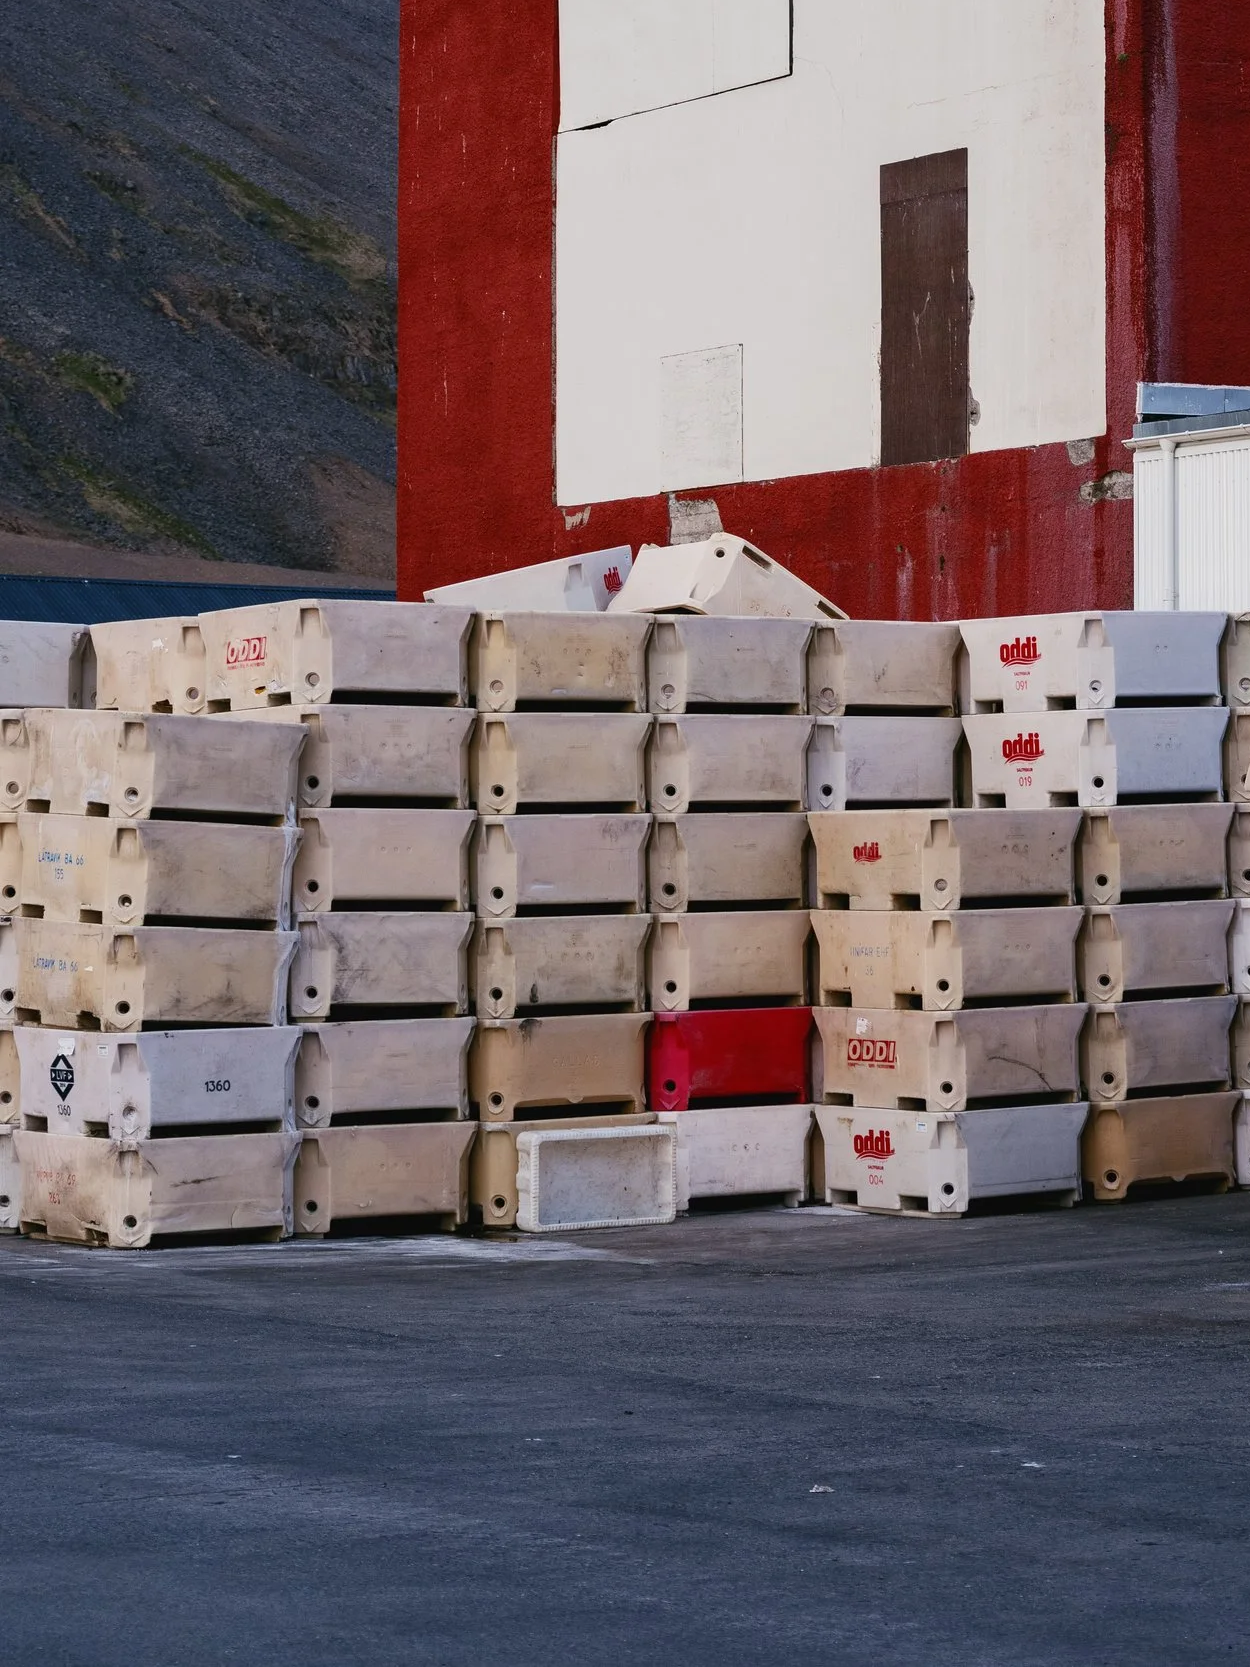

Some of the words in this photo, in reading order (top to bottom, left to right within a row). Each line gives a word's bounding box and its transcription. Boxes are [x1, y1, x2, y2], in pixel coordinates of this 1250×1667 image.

[1000, 636, 1038, 663] oddi
[1015, 680, 1028, 691] 091
[1002, 732, 1040, 759] oddi
[1018, 776, 1032, 787] 019
[853, 842, 879, 860] oddi
[848, 1039, 897, 1063] ODDI
[204, 1079, 231, 1093] 1360
[57, 1104, 71, 1116] 1360
[854, 1129, 891, 1154] oddi
[868, 1174, 884, 1185] 004
